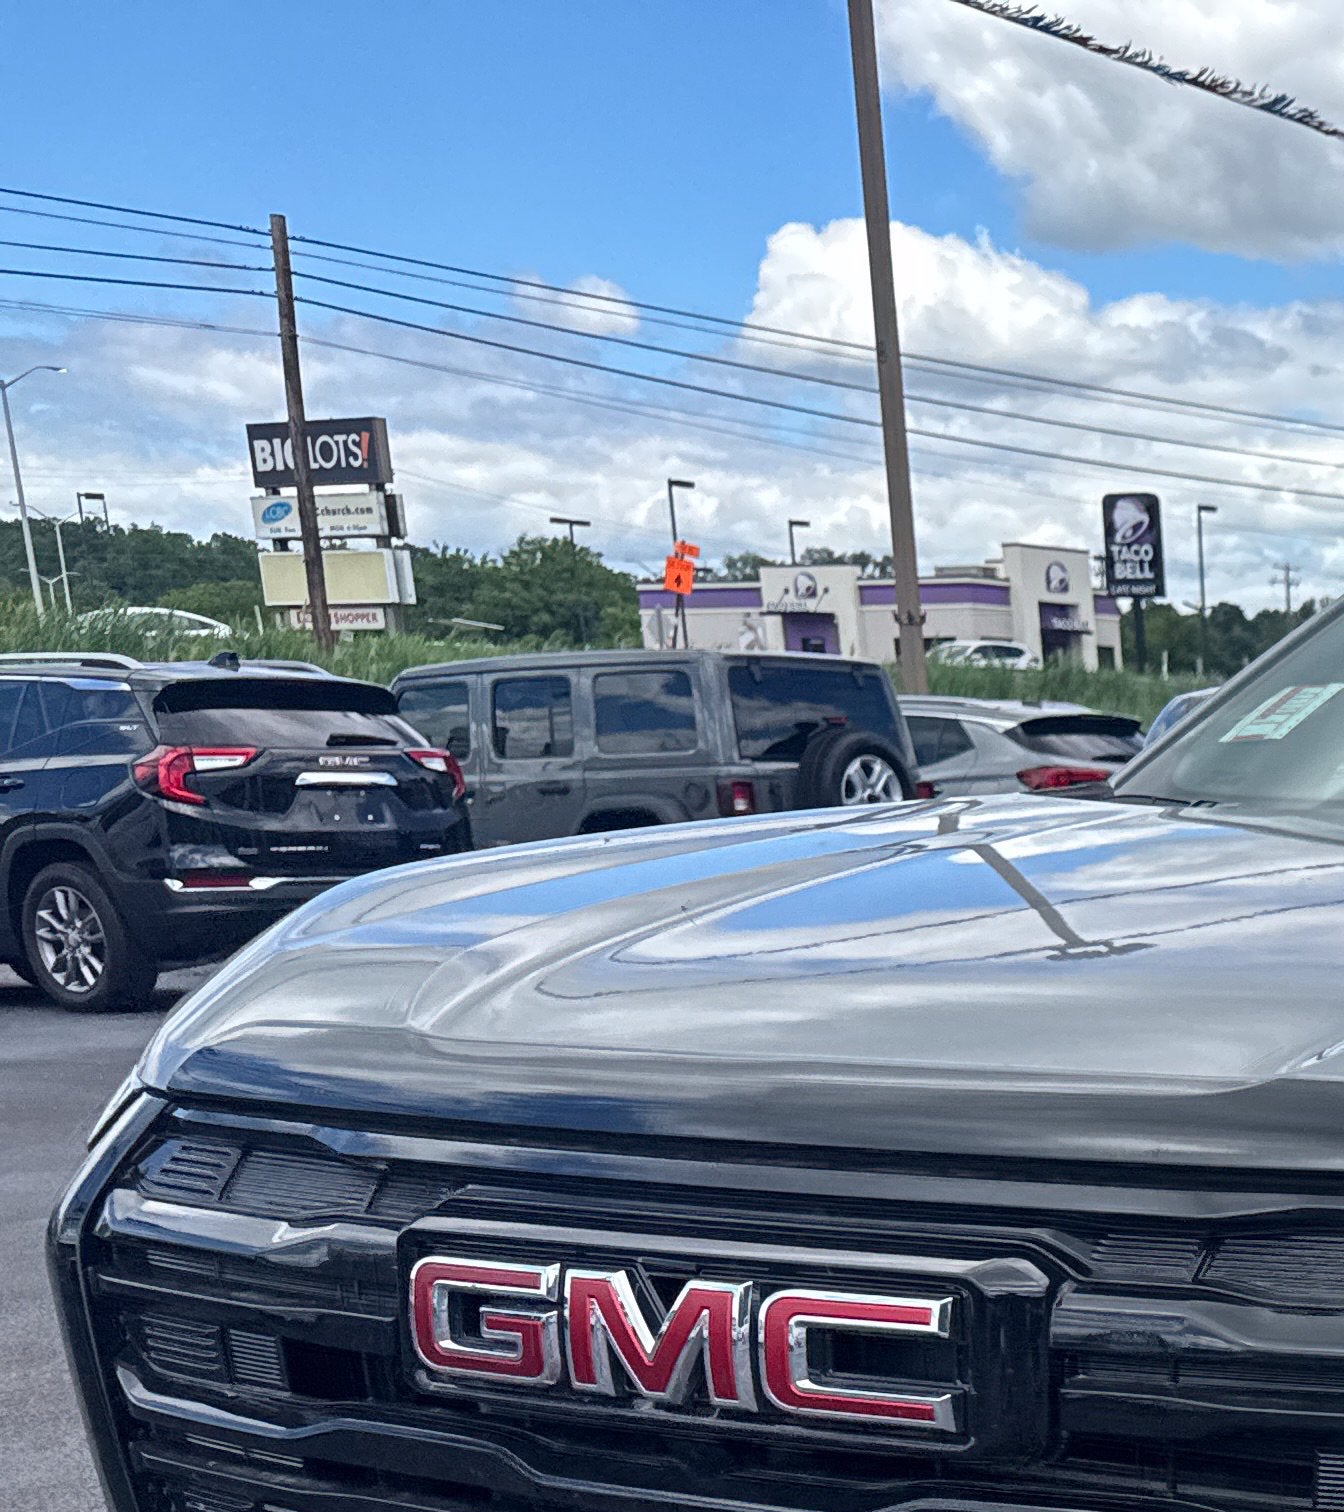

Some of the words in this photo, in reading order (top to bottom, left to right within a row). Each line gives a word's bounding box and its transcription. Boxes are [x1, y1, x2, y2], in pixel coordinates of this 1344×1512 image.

[306, 431, 370, 470] LOTS!
[1110, 543, 1154, 562] TACO
[1114, 561, 1155, 580] BELL
[333, 611, 379, 625] SHOPPER
[408, 1255, 956, 1433] GMC
